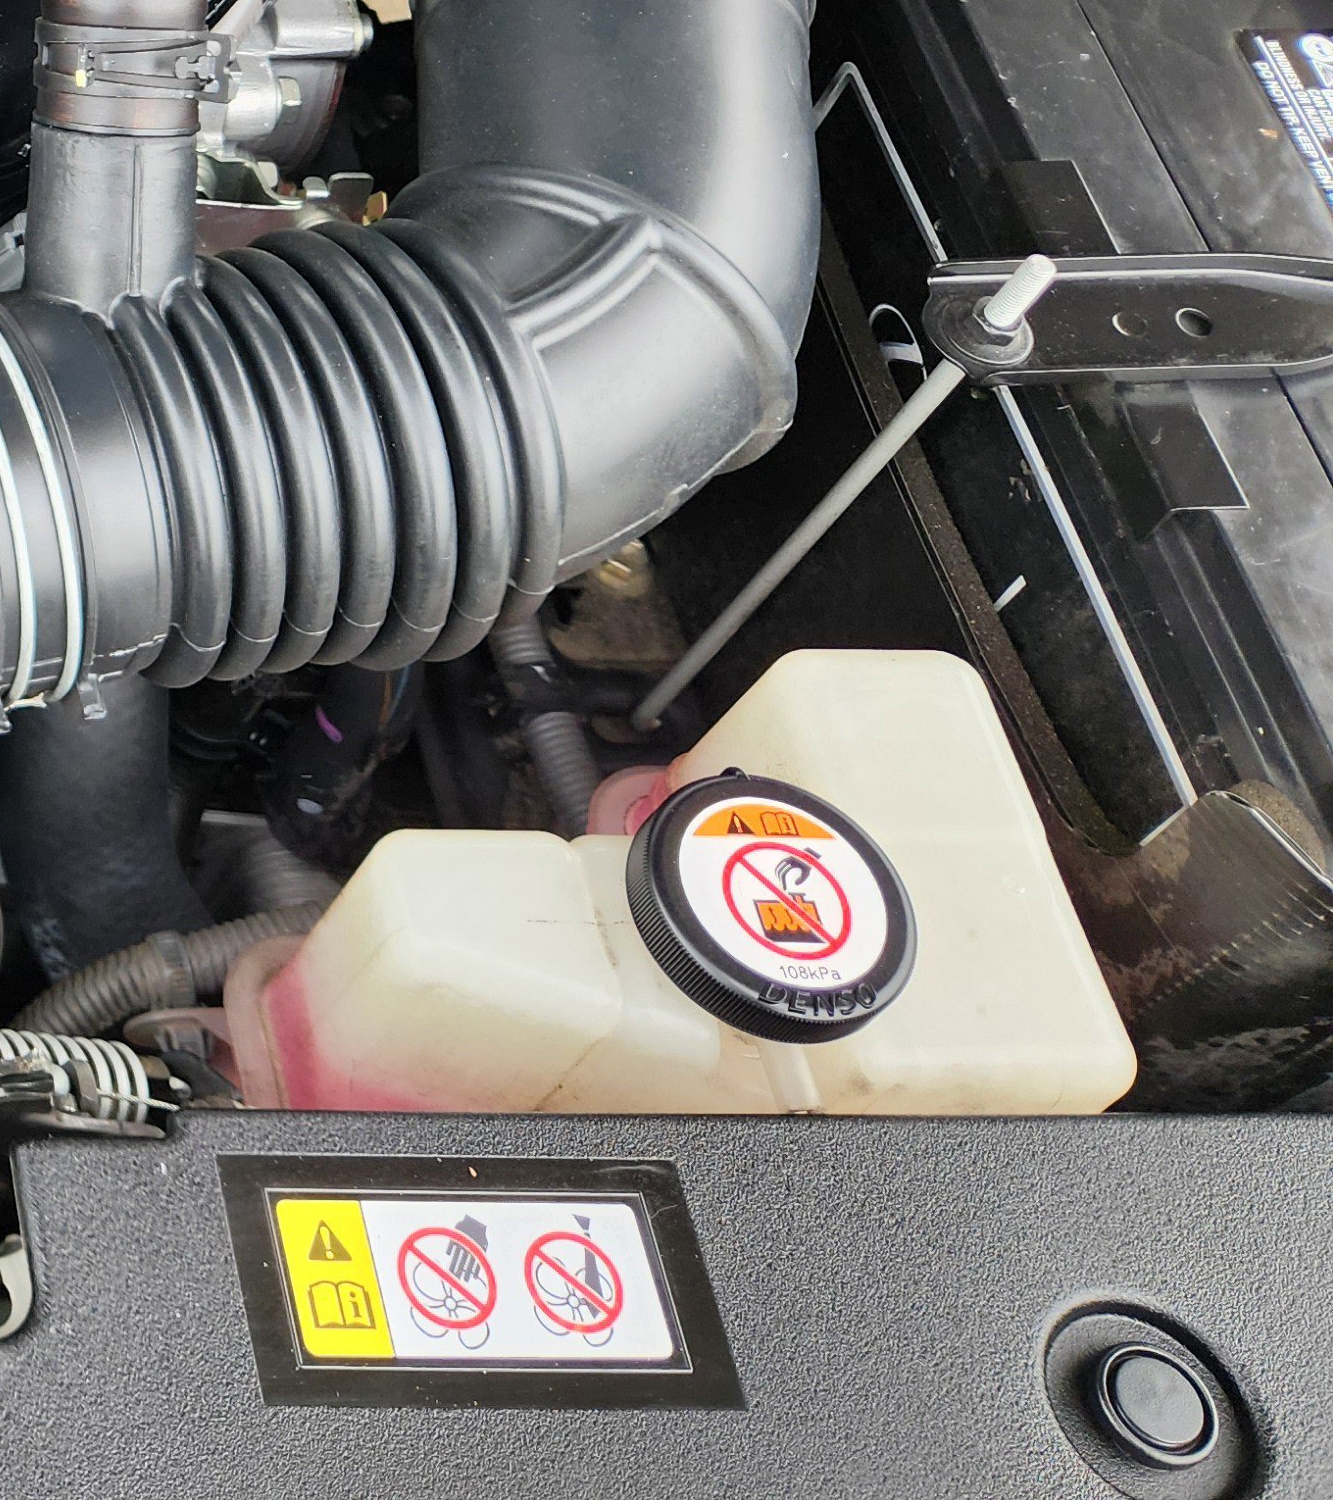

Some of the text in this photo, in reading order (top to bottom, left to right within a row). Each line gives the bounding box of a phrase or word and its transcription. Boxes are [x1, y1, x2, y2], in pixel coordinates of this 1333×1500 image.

[1252, 60, 1275, 80] DO
[1265, 40, 1304, 90] BLINDNESS
[1294, 90, 1312, 105] OR
[1261, 80, 1290, 106] NOT
[1289, 127, 1320, 160] KEEP
[779, 965, 842, 980] 108kPa
[758, 982, 877, 1017] DENSO
